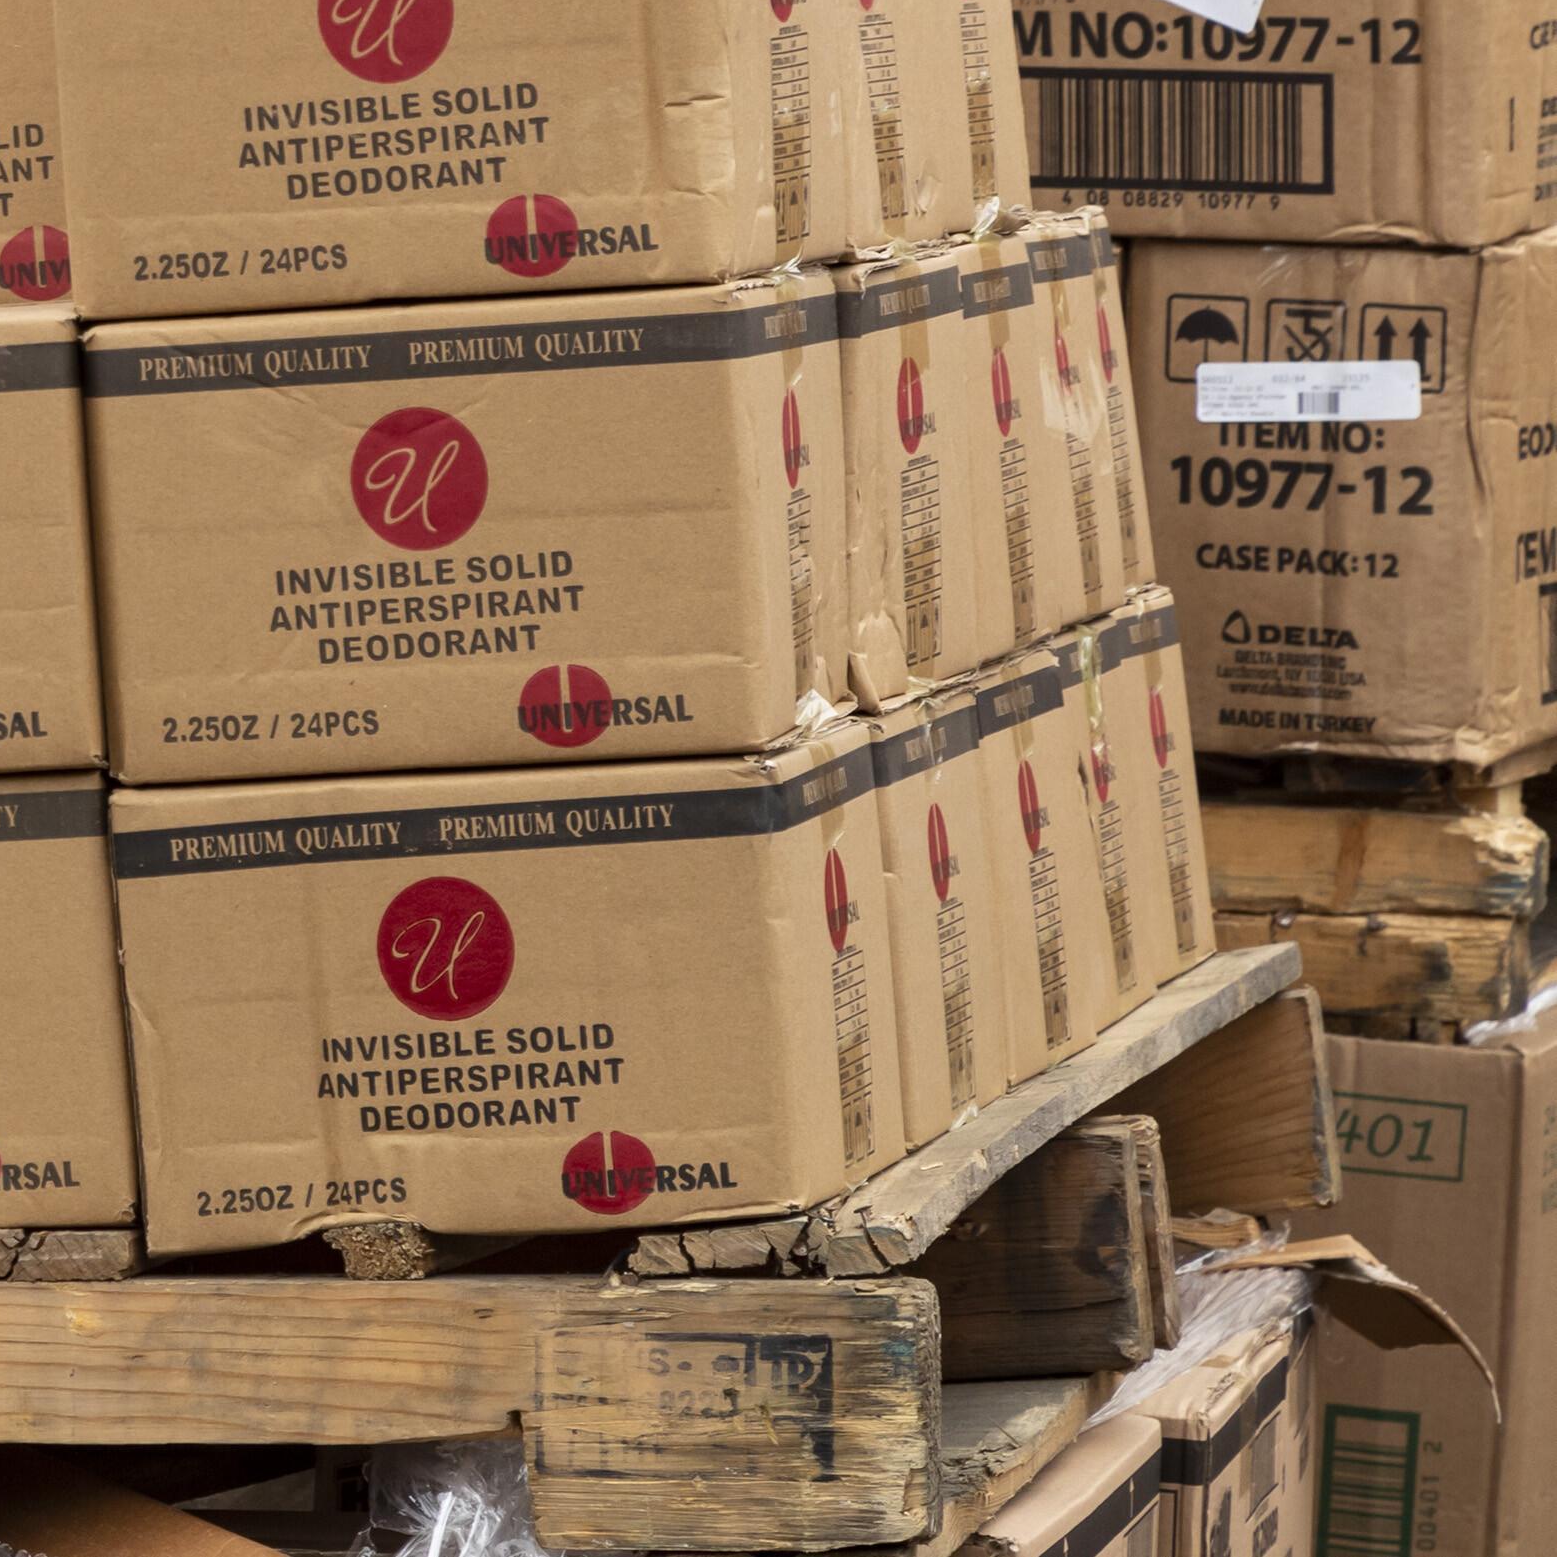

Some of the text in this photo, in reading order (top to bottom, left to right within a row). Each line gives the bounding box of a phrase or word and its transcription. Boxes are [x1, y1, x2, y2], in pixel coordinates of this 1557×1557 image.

[244, 83, 537, 138] INVISIBLE SOLID
[239, 112, 549, 174] ANTIPERSPIRANT
[287, 152, 506, 200] DEODORANT
[1087, 191, 1109, 206] 08
[1123, 192, 1184, 207] 08829
[1198, 194, 1256, 209] 10977
[1271, 195, 1280, 211] 9
[1320, 422, 1385, 454] NO:
[1171, 455, 1434, 516] 10977-12
[276, 551, 572, 595] INVISIBLE SOLID
[1196, 543, 1267, 572] CASE
[271, 579, 584, 637] ANTIPERSPIRANT
[319, 625, 540, 664] DEODORANT
[1258, 625, 1359, 649] DELTA
[1219, 709, 1377, 733] MADE IN TURKEY
[393, 912, 486, 1000] U
[1337, 1108, 1435, 1163] 401
[198, 1178, 406, 1216] 2.25OZ / 24PCS
[562, 1162, 738, 1200] UNIVERSAL
